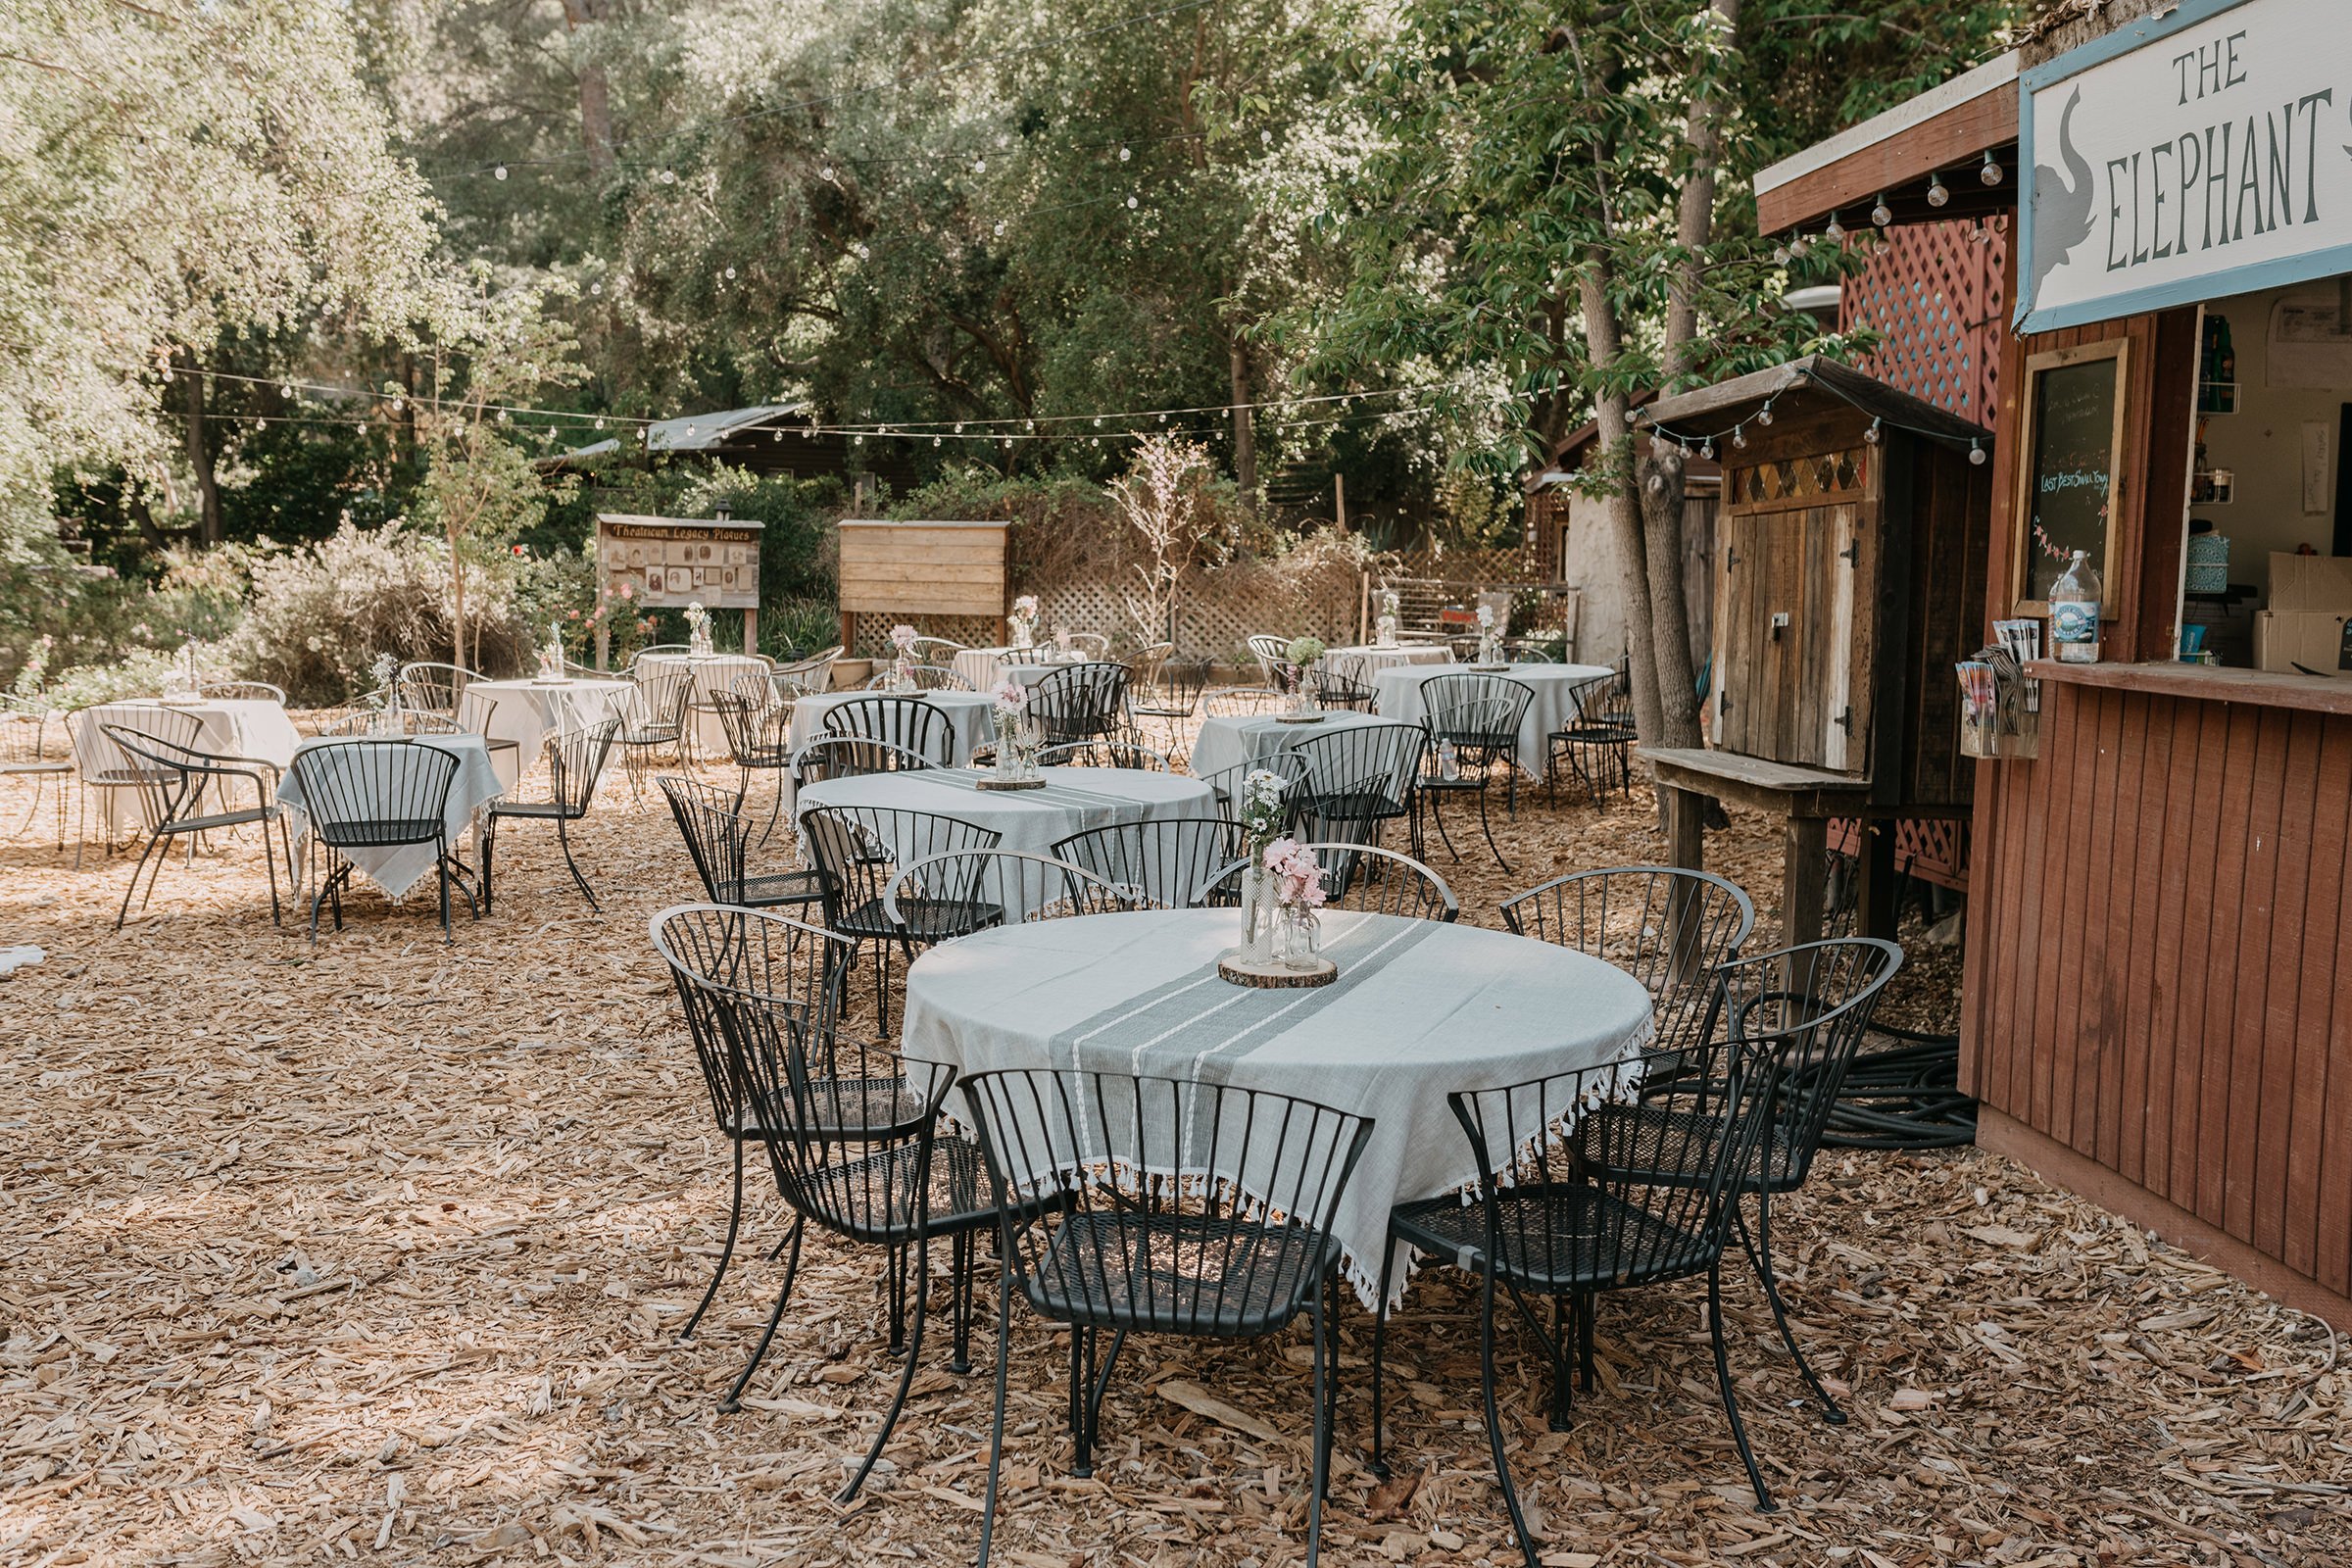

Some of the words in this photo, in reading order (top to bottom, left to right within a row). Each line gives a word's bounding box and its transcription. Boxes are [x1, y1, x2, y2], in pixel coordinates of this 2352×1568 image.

[2173, 29, 2247, 106] THE
[2106, 87, 2332, 272] ELEPHANT
[613, 524, 668, 538] Theatricum
[673, 527, 710, 541] Legacy
[713, 529, 750, 541] Plaques
